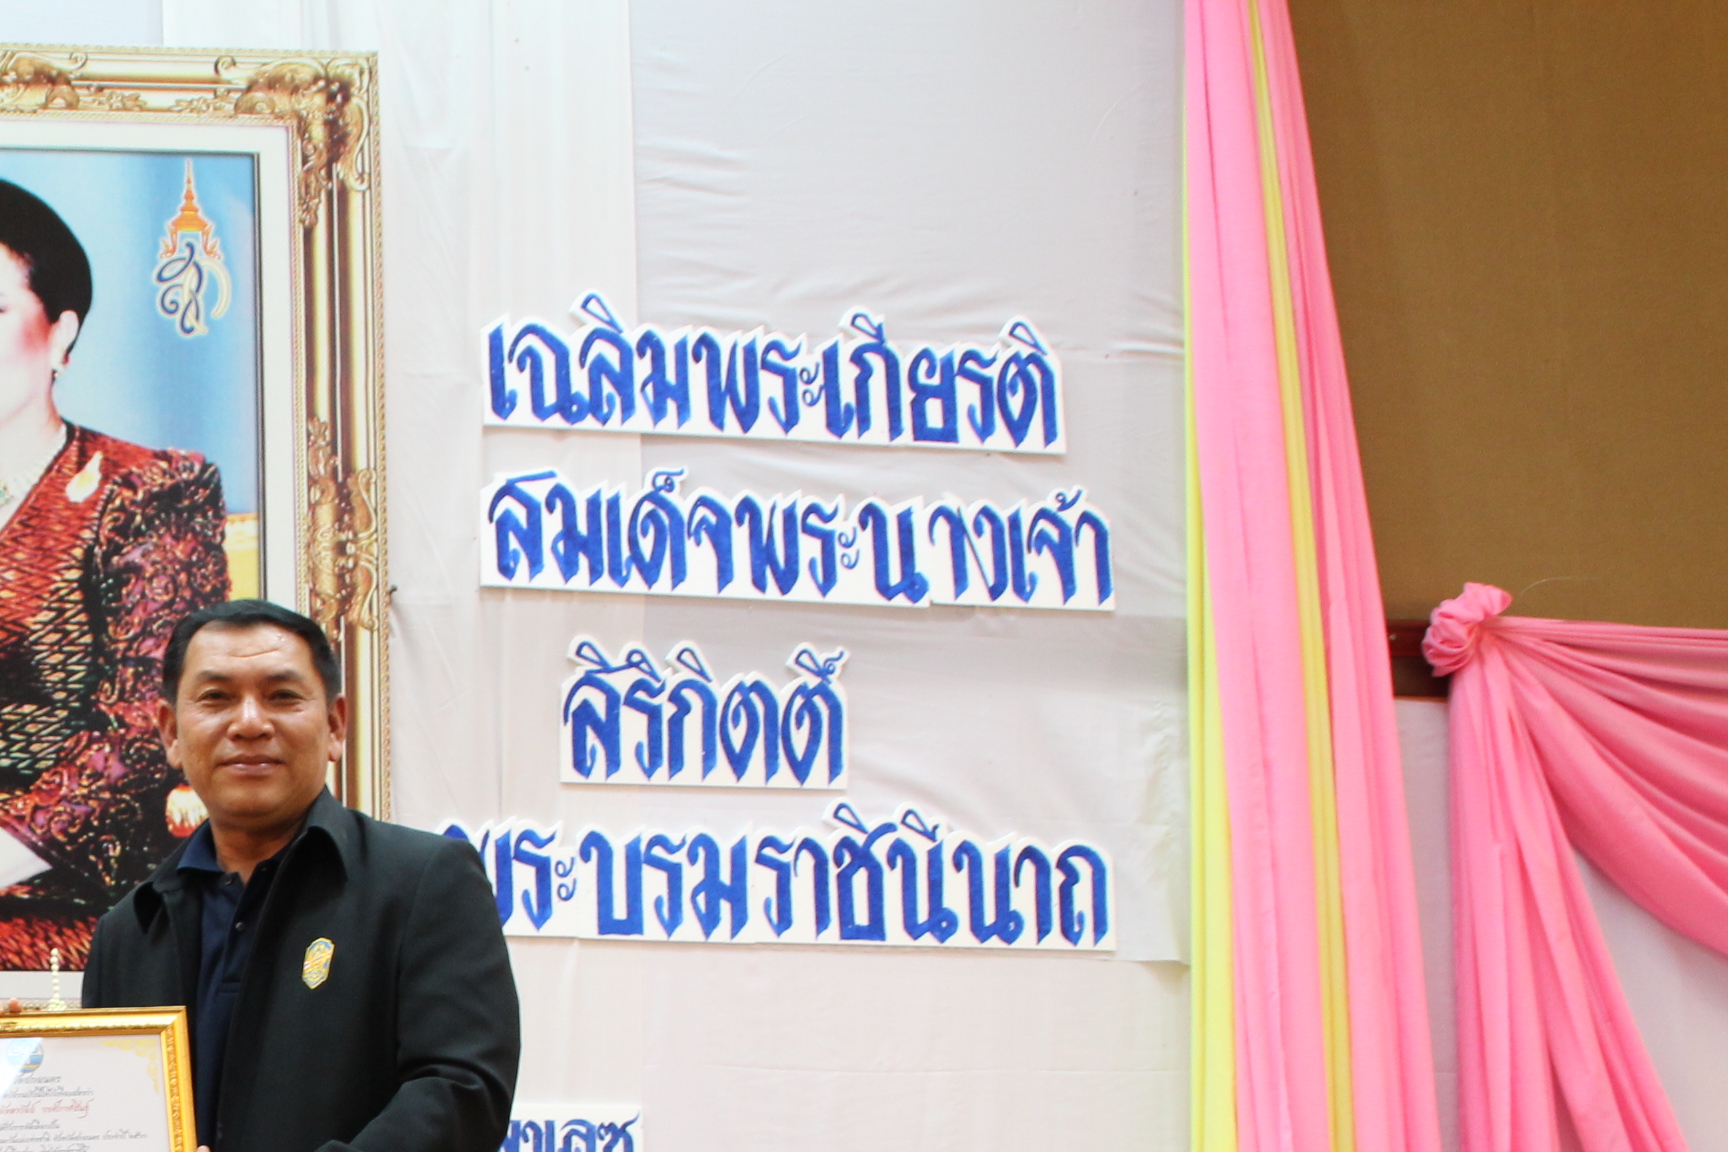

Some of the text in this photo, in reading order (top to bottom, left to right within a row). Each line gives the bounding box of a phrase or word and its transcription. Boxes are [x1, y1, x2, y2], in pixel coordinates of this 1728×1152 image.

[488, 292, 1058, 447] เฉลิมพระเกียรติ
[487, 468, 1113, 604] สมเด็จพระนางเจ้า
